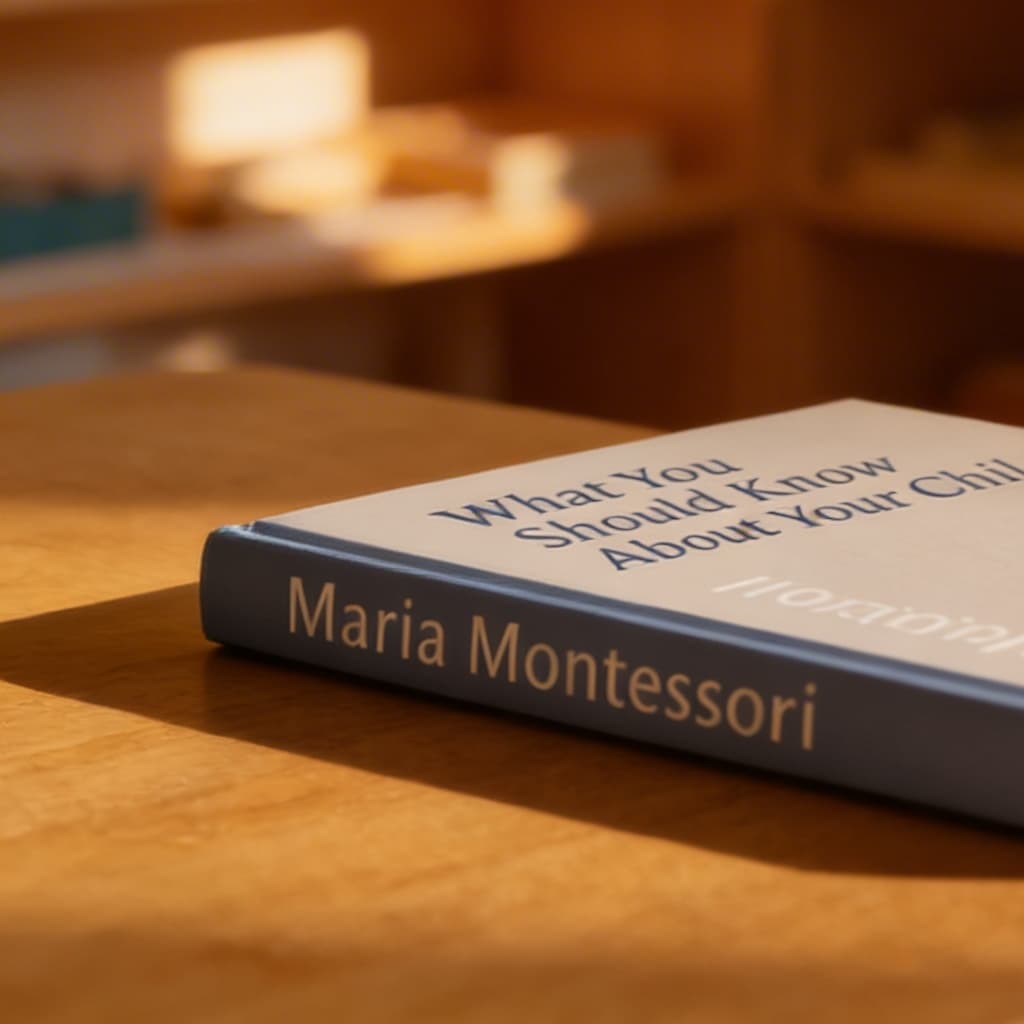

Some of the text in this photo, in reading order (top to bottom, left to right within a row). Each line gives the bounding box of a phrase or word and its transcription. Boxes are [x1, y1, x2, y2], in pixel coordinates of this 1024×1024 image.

[429, 456, 743, 529] What You
[513, 455, 900, 550] Should Know
[598, 515, 782, 572] About
[768, 490, 913, 531] Your
[288, 576, 446, 668] Maria
[468, 615, 818, 751] Montessori
